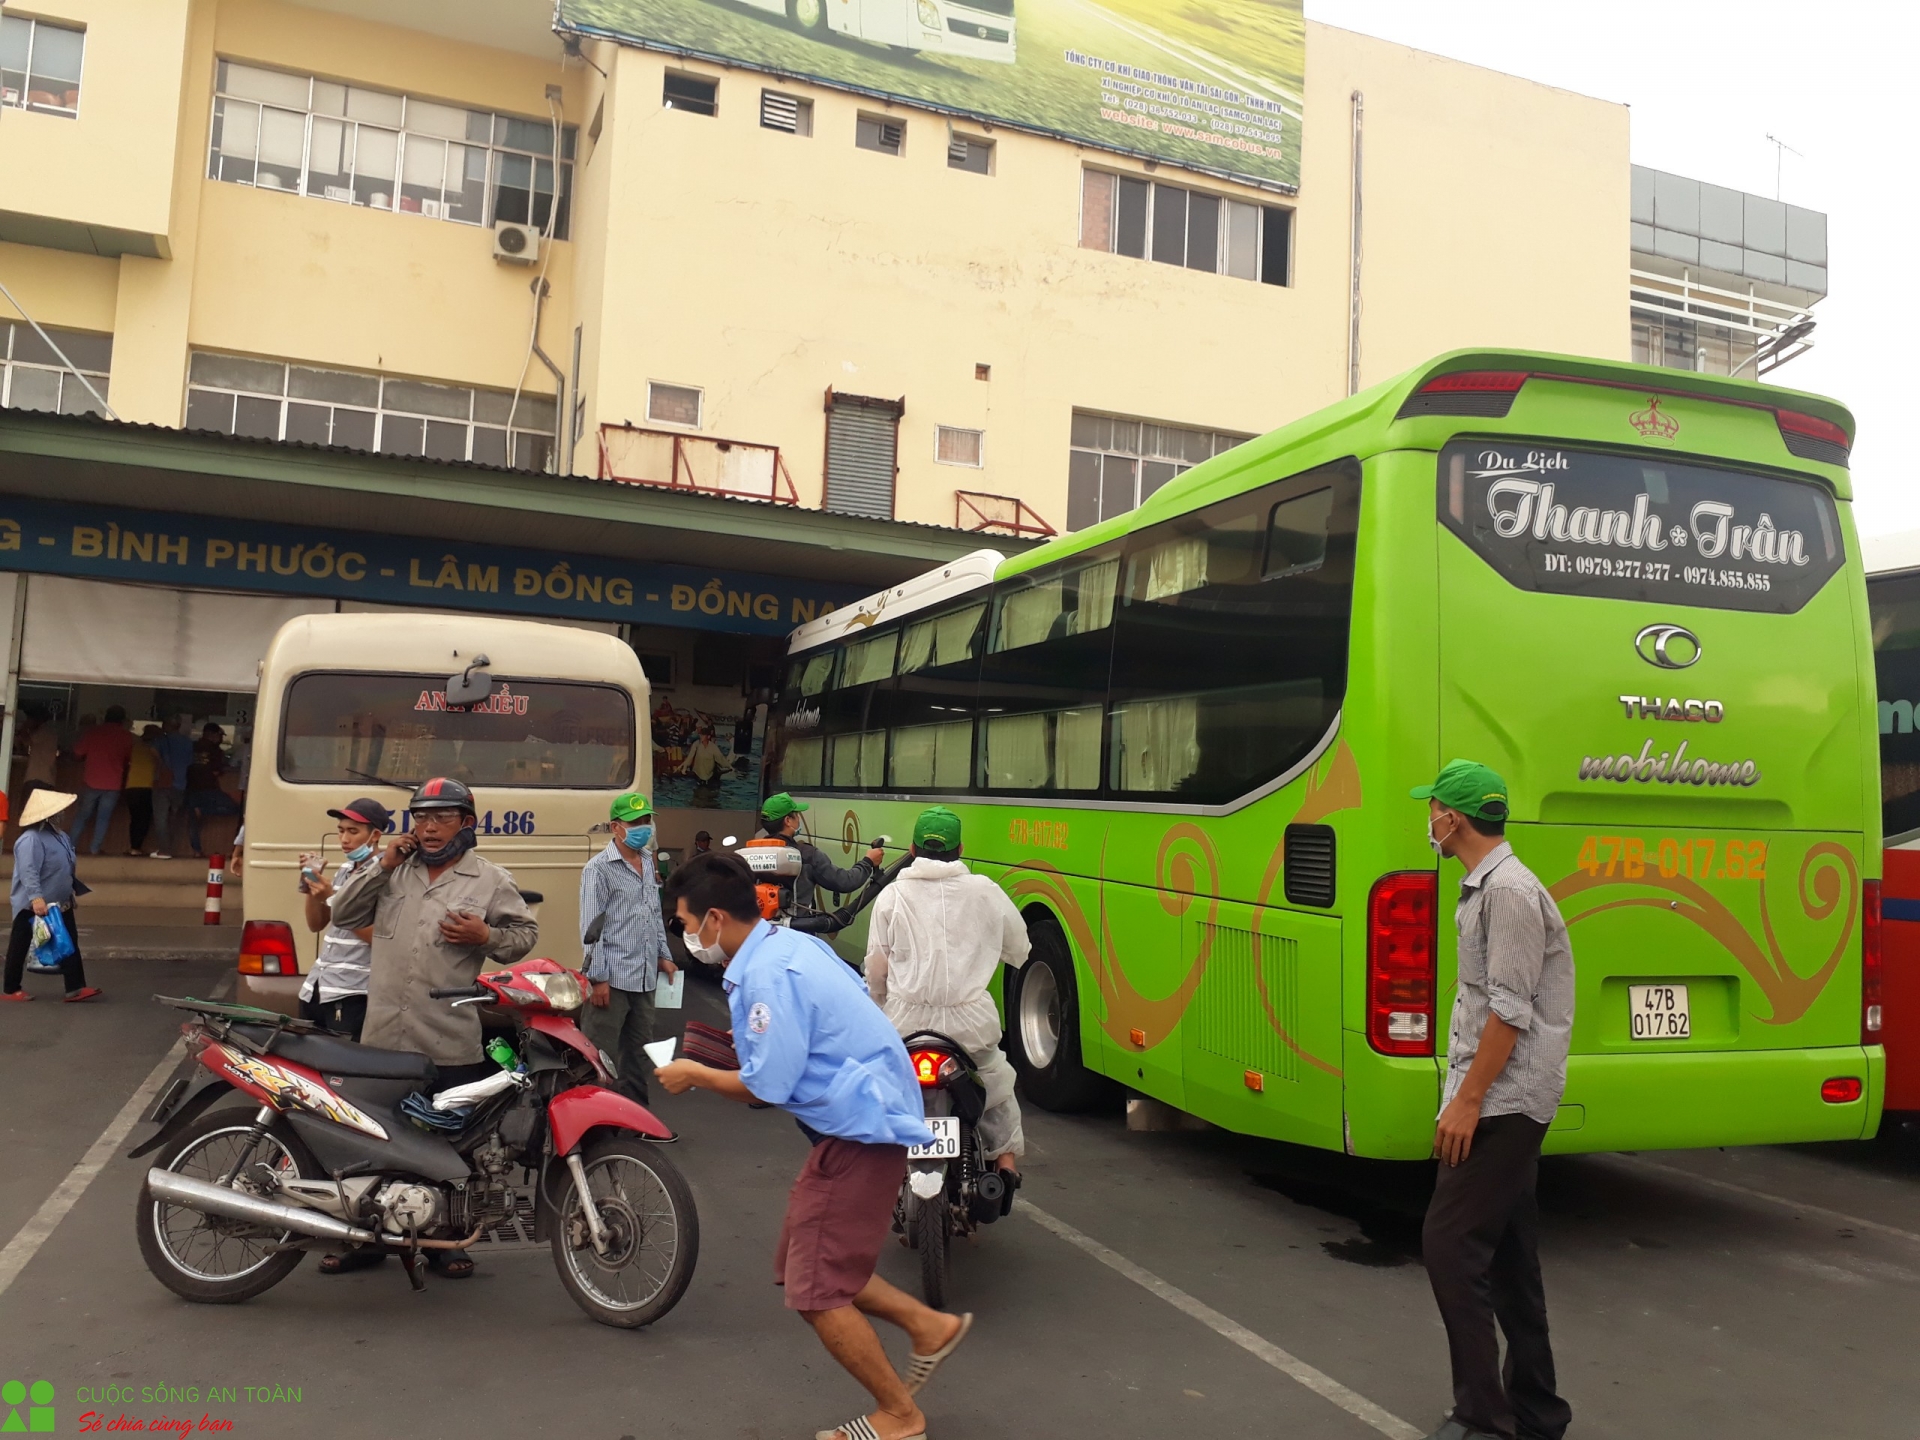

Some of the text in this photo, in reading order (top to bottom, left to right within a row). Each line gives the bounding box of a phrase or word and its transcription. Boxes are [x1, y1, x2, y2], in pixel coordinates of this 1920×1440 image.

[1087, 56, 1103, 69] CTY
[1104, 60, 1116, 73] CƠ
[1117, 64, 1131, 77] KHÍ
[1133, 67, 1151, 81] GIAO
[1153, 73, 1178, 89] THÔNG
[1246, 96, 1265, 110] TNHH
[1266, 101, 1282, 114] MTV
[1124, 99, 1148, 112] (028)
[1211, 119, 1234, 133] (028)
[1191, 100, 1202, 110] AN
[1220, 107, 1251, 122] (SAMCO
[1252, 116, 1264, 126] AN
[1101, 108, 1282, 159] website: www.samcobus.vn
[1478, 450, 1570, 475] Du Lịch
[1486, 477, 1810, 567] Thanh Trân
[71, 522, 189, 566] BÌNH
[205, 538, 367, 582] PHƯỚC
[409, 554, 499, 594] LÂM
[514, 561, 634, 606] ĐỒNG
[671, 577, 779, 621] ĐỒNG
[1575, 555, 1671, 582] 0979.277.277
[415, 690, 465, 712] AN
[1618, 695, 1724, 723] THACO
[1578, 737, 1762, 788] mobihome
[1577, 835, 1767, 880] 47B-017.62
[1645, 988, 1675, 1011] 47B
[1634, 1012, 1689, 1036] 017.62
